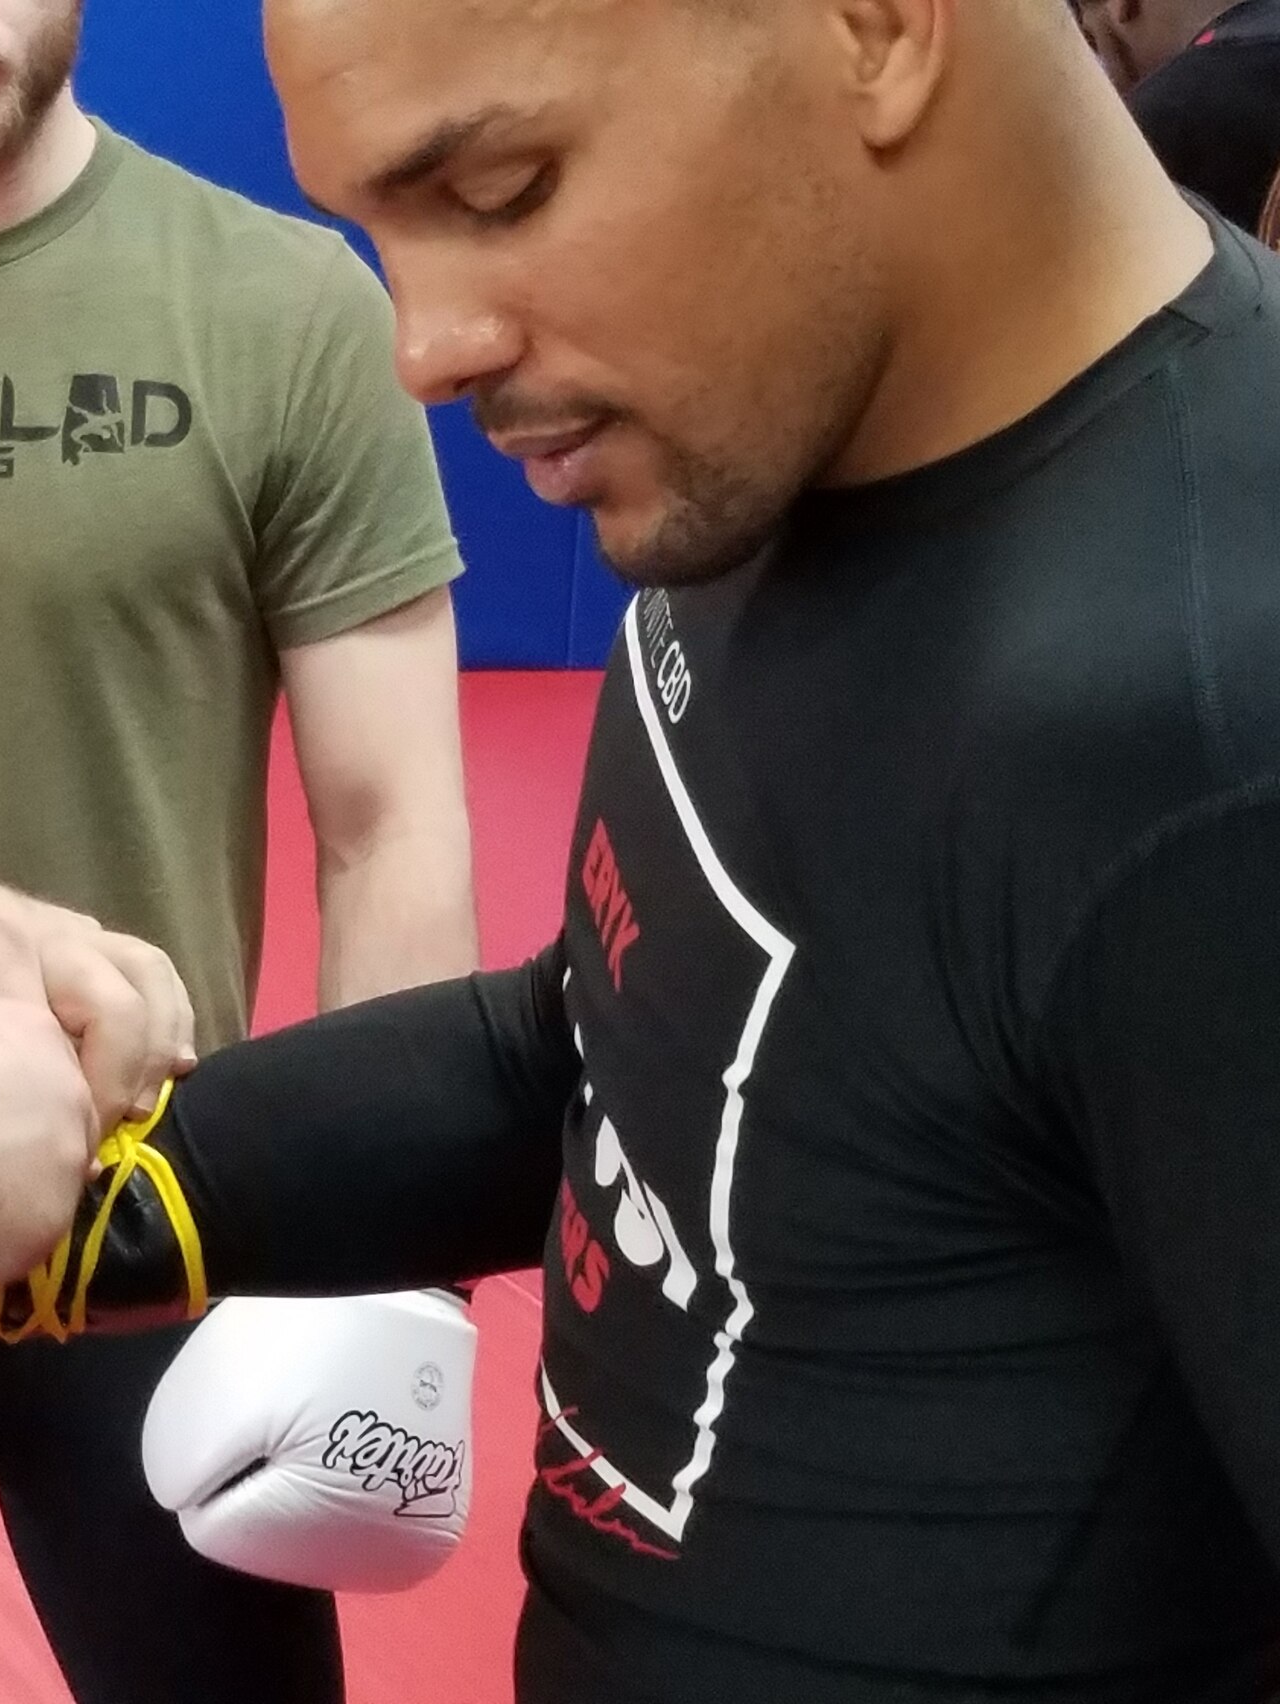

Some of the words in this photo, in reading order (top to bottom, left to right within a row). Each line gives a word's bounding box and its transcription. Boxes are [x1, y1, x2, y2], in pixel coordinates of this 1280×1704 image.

[657, 640, 691, 724] CBD
[582, 816, 641, 992] ERYK
[322, 1410, 466, 1518] Fairtex
